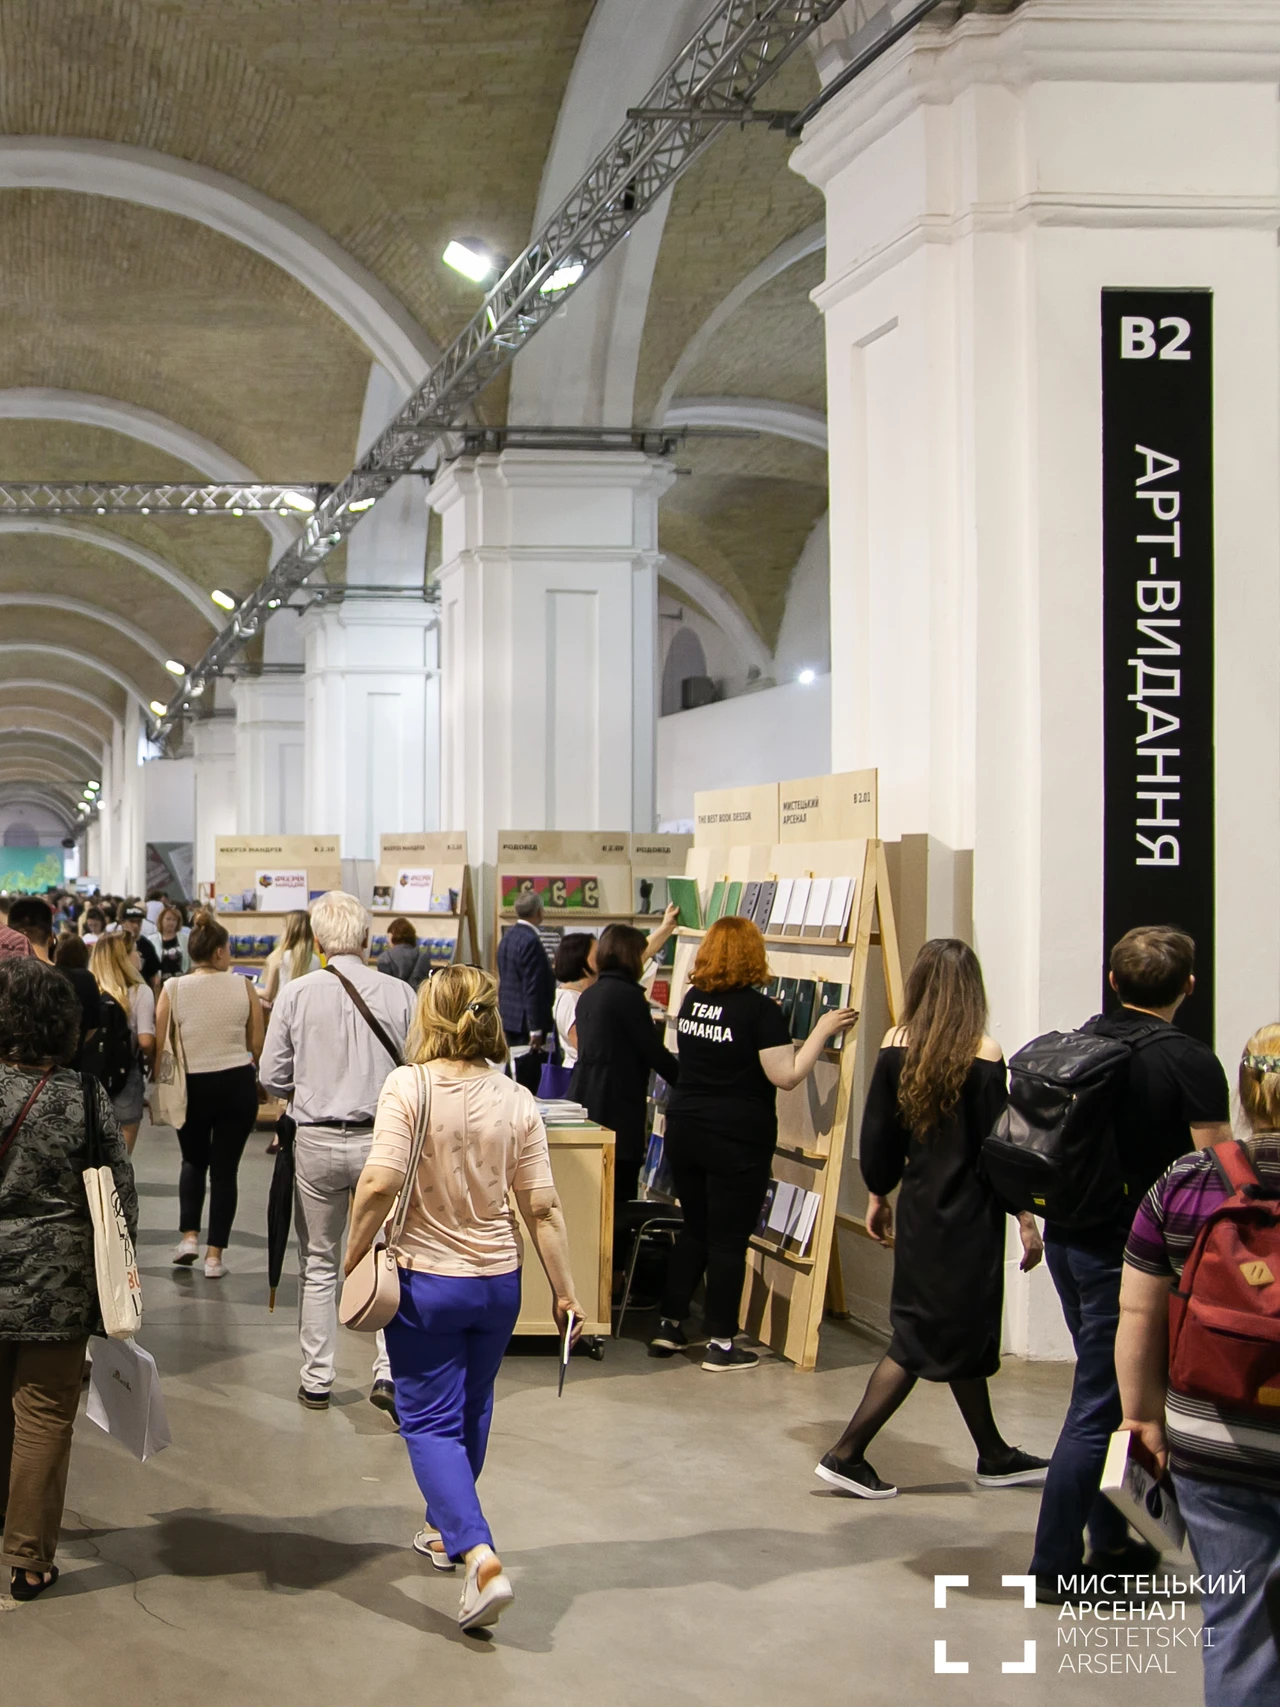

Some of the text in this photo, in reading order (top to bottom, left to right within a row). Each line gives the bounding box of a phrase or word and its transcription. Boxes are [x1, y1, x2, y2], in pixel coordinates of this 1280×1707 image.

[1120, 315, 1191, 361] B2
[1127, 443, 1181, 866] АРТ-ВИДАННЯ
[782, 796, 819, 812] МИСТЕЦЬКИЙ
[698, 811, 751, 824] THE BEST BOOK DESIGN
[782, 812, 807, 825] АРСЕНАЛ
[691, 1002, 723, 1021] TEAM
[678, 1017, 734, 1043] КОМАНДА
